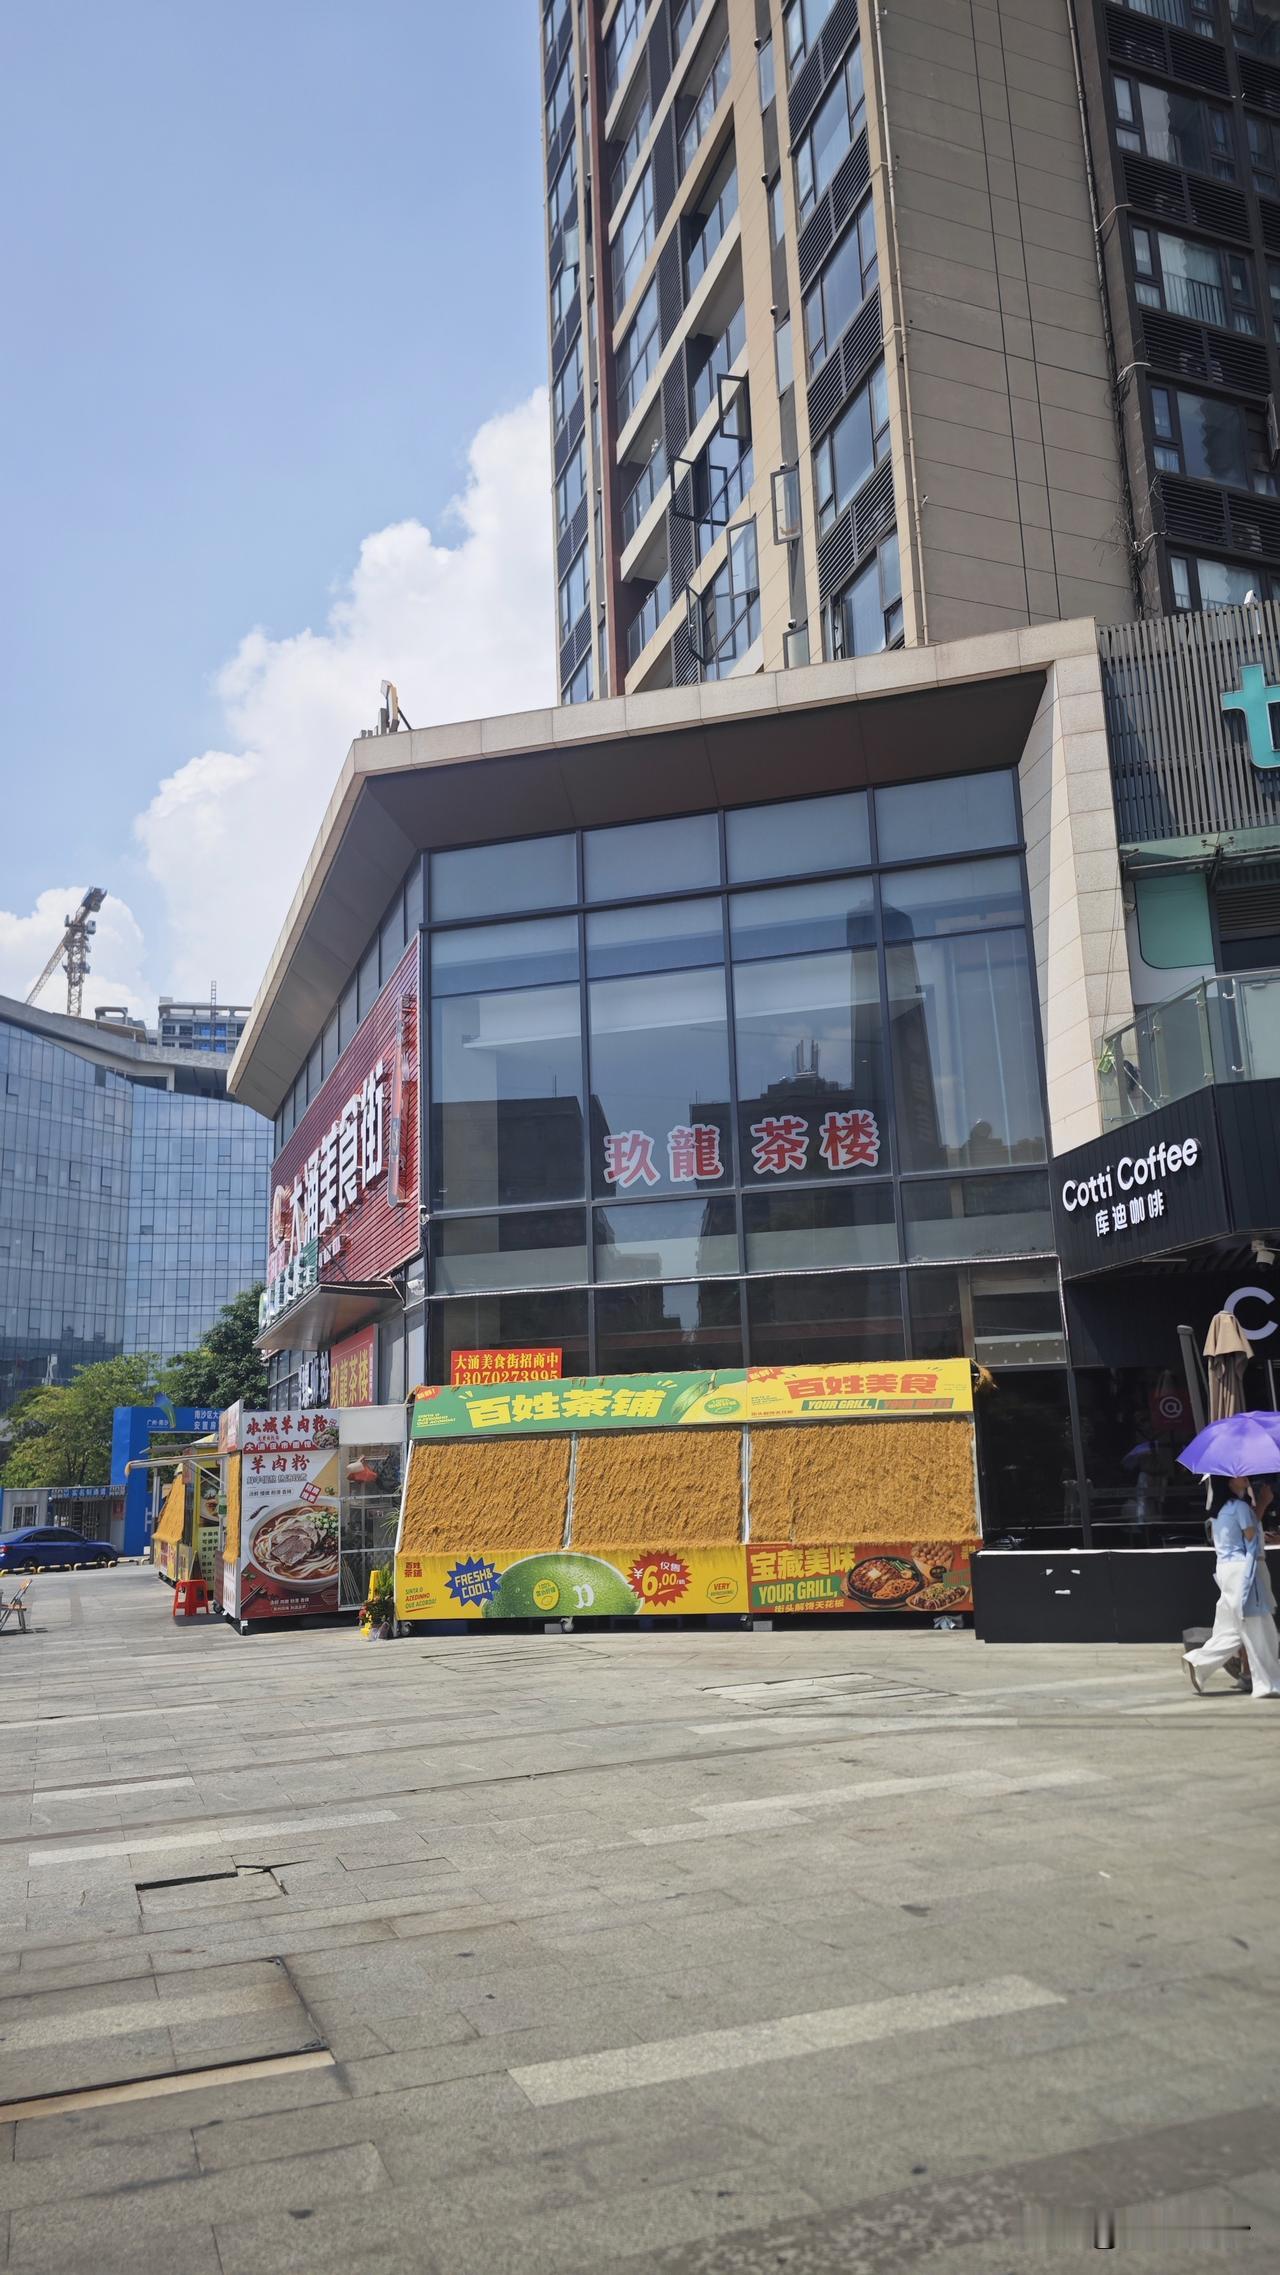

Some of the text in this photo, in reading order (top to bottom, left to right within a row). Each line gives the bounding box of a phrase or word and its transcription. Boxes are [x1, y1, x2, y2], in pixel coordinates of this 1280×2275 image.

[1062, 1138, 1200, 1212] Cotti Coffee
[1095, 1189, 1165, 1237] 库迪咖啡
[454, 1354, 559, 1371] 大涌美食街招商中
[784, 1373, 938, 1400] 百姓美食
[465, 1389, 667, 1429] 百姓茶铺
[808, 1400, 839, 1410] YOUR
[251, 1453, 310, 1475] 羊肉粉
[750, 1546, 856, 1582] 宝藏美味
[455, 1568, 493, 1587] FRESH&
[714, 1582, 730, 1590] VERY
[462, 1581, 491, 1598] COOL!
[759, 1579, 838, 1604] YOUR GRILL,
